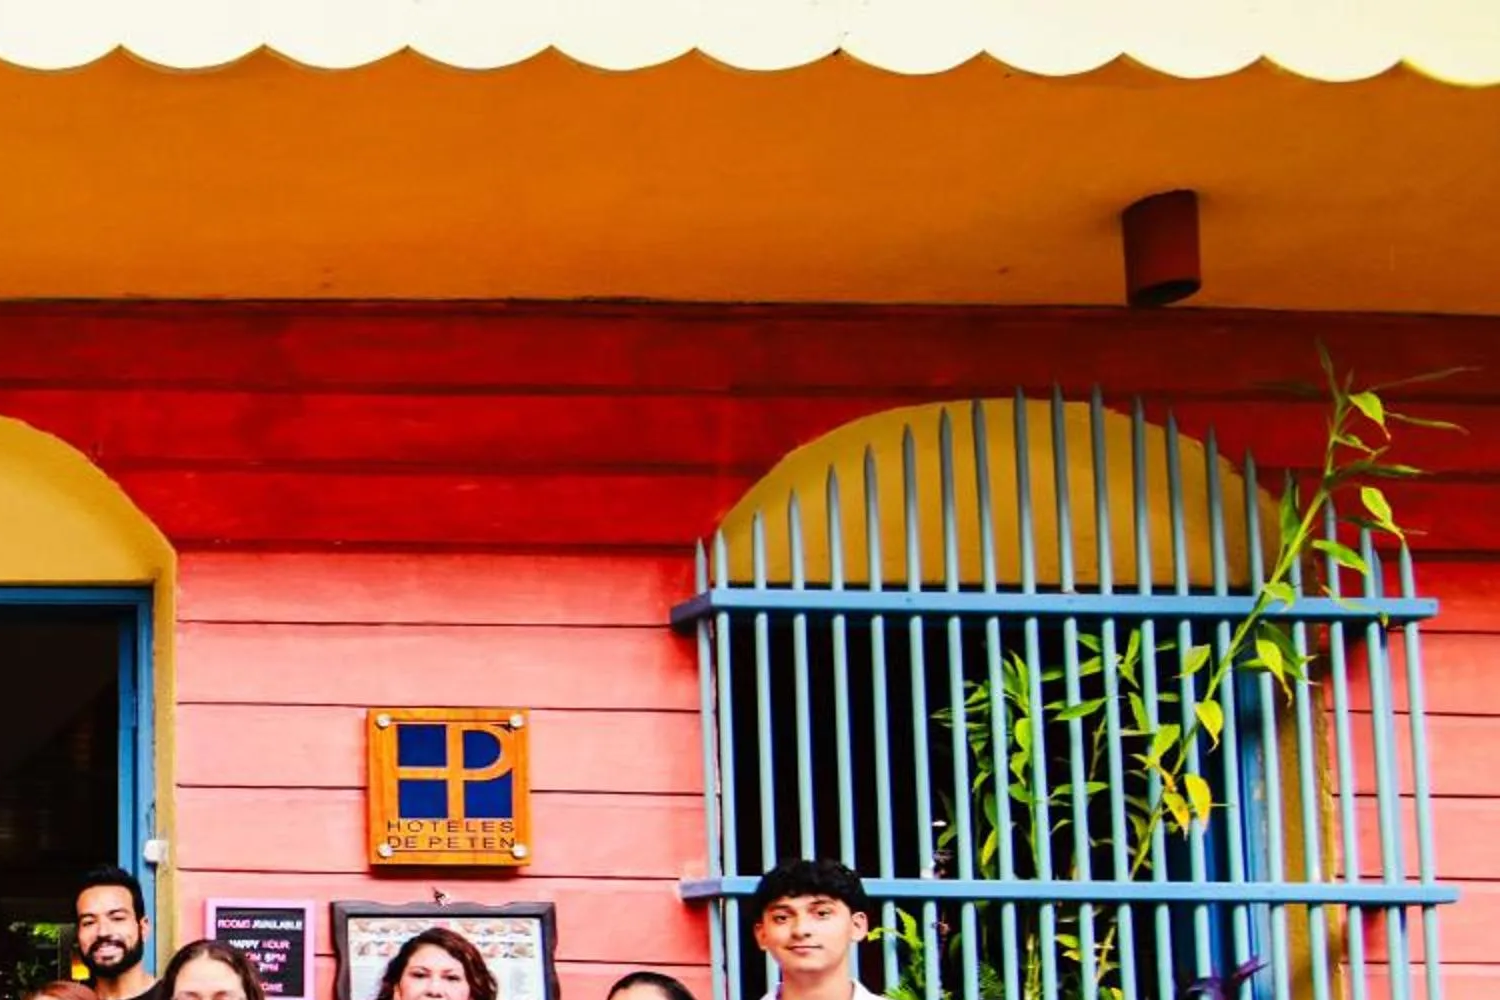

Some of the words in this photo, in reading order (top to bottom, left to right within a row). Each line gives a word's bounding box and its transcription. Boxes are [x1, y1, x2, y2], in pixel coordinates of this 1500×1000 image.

[387, 819, 516, 833] HOTELES
[387, 835, 419, 849] DE
[429, 836, 516, 849] PETEN
[217, 919, 251, 929] ROOMS
[251, 919, 303, 931] AVAILABLE
